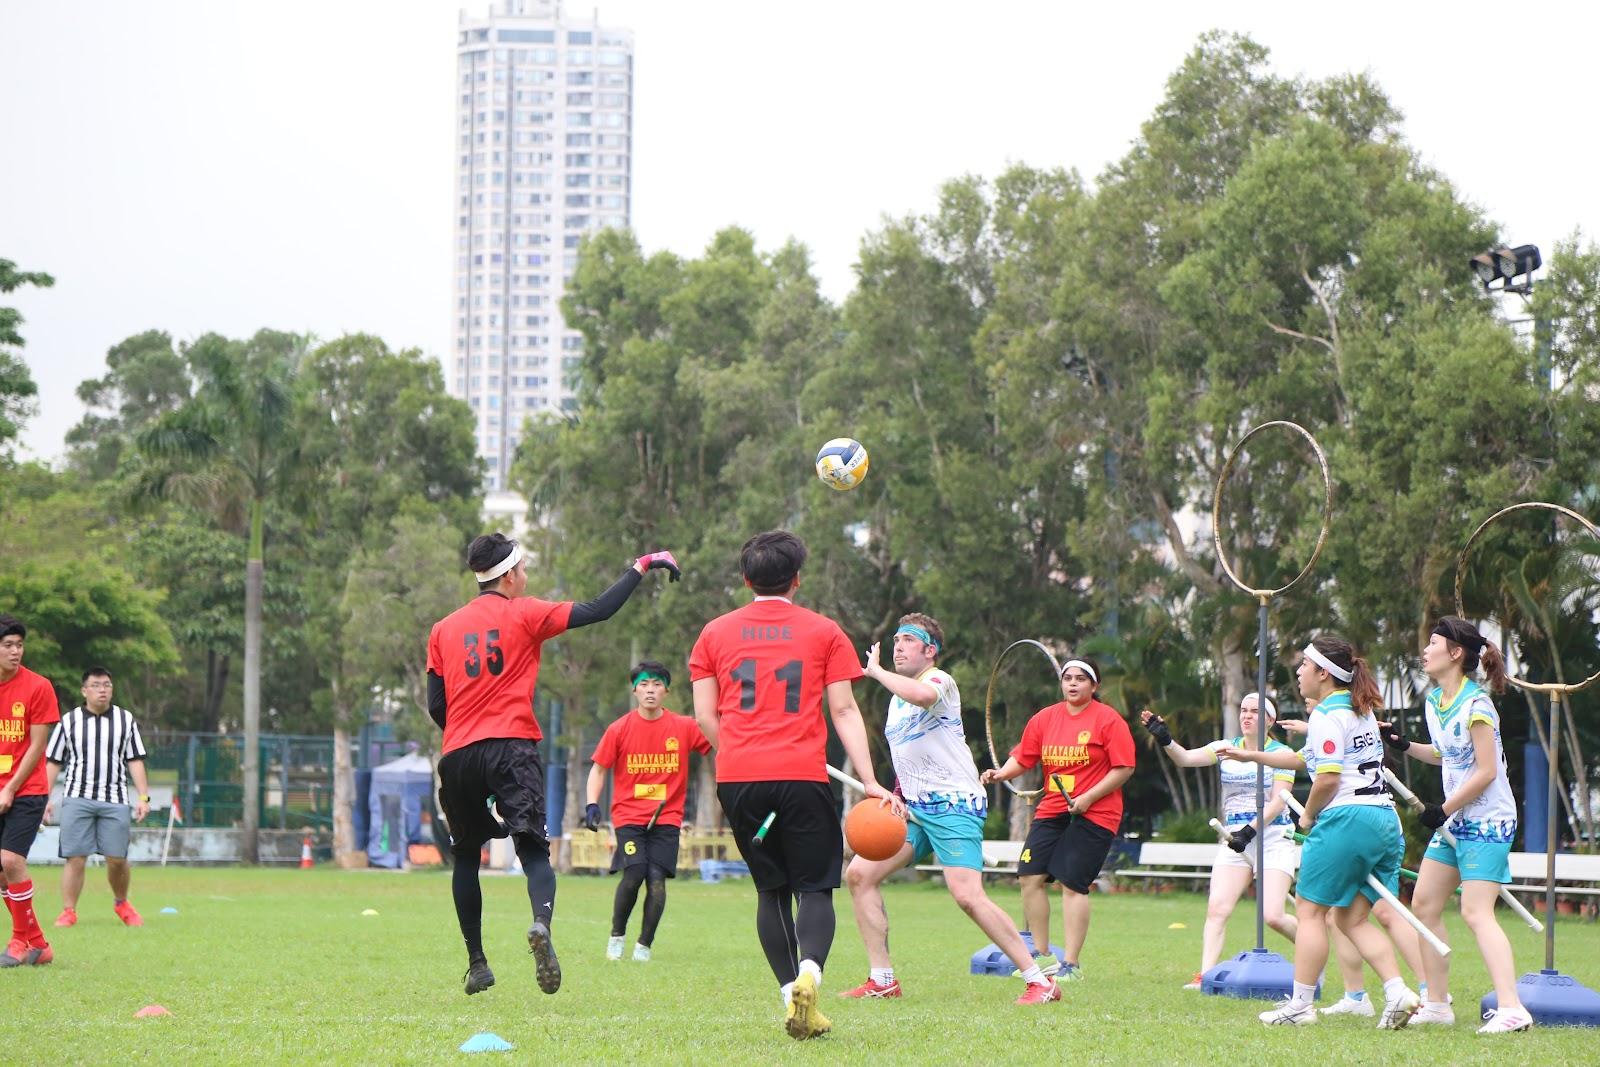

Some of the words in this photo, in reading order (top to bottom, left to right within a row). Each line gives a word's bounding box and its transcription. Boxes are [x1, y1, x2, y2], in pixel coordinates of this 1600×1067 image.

[741, 626, 793, 640] HIDE
[463, 628, 504, 679] 35
[729, 658, 804, 714] 11
[624, 841, 637, 855] 6
[1020, 849, 1032, 864] 4
